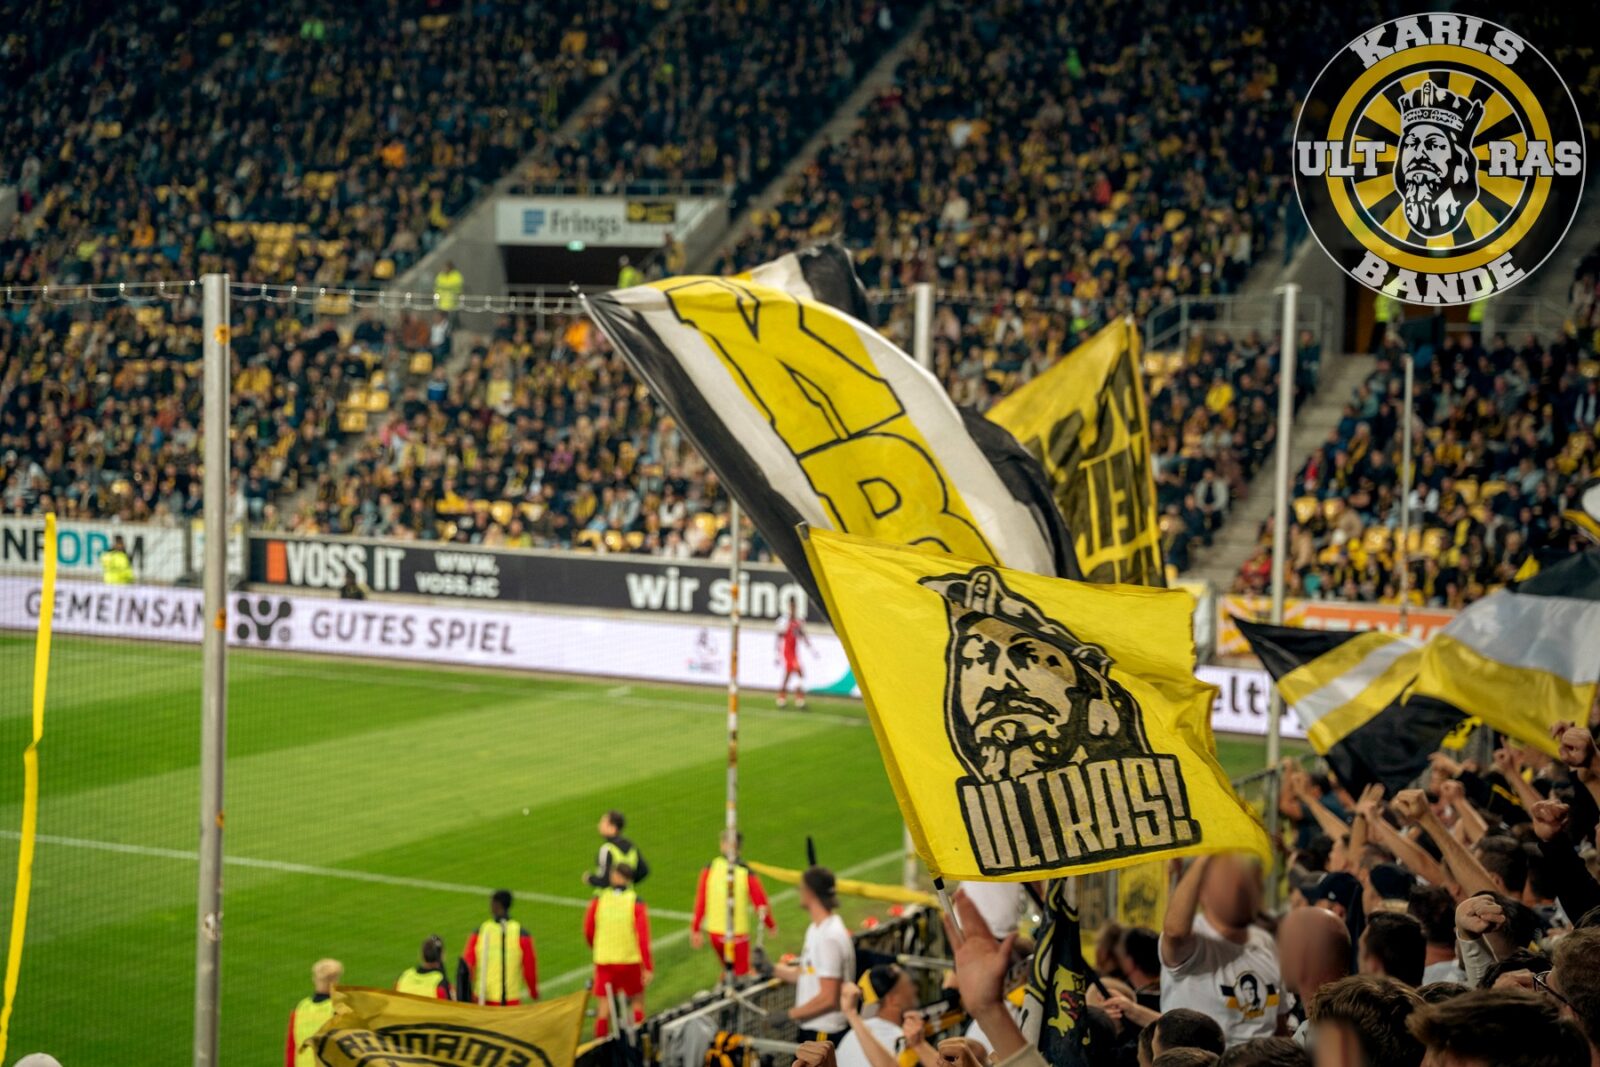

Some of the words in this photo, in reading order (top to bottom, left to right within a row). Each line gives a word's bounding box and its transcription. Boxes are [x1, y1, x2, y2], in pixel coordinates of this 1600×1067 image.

[551, 209, 621, 241] Frings
[286, 540, 369, 590] VOSS
[373, 545, 405, 592] IT
[626, 567, 699, 611] wir
[311, 609, 416, 645] GUTES
[426, 617, 514, 654] SPIEL
[962, 757, 1193, 869] ULTRAS!
